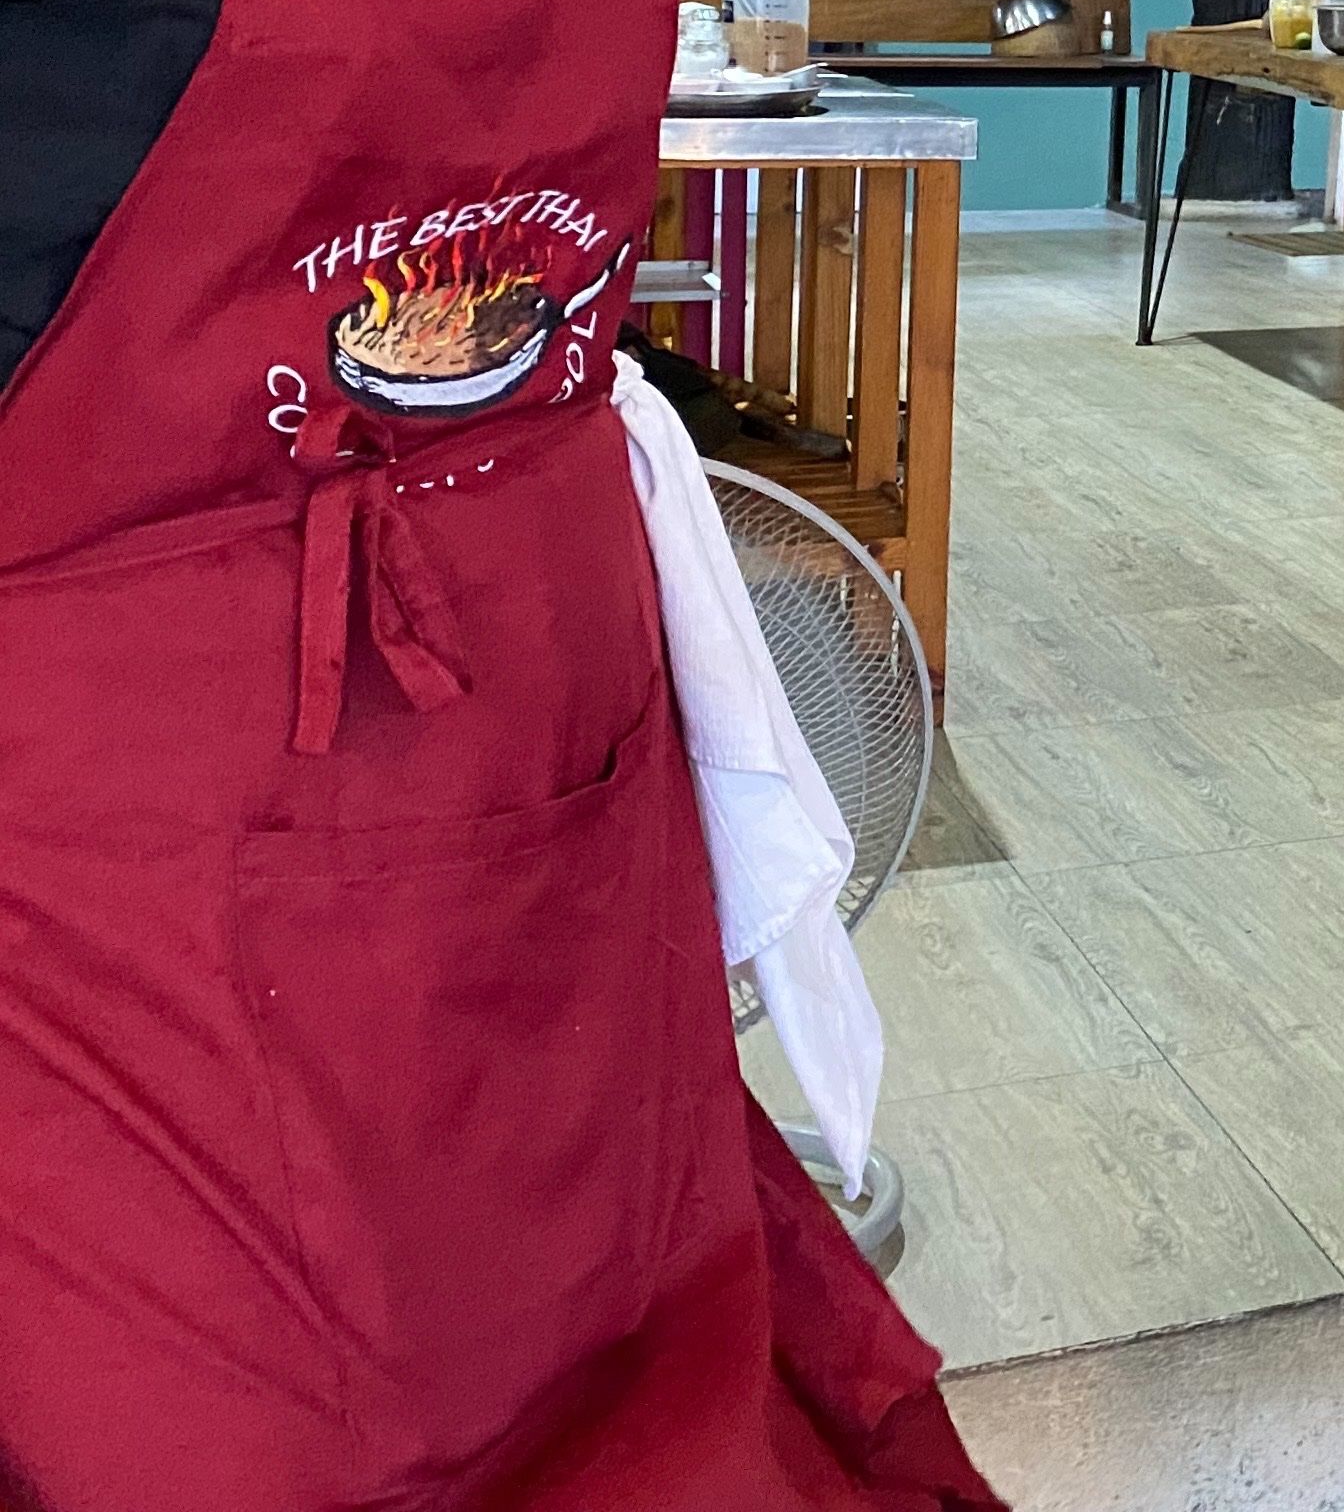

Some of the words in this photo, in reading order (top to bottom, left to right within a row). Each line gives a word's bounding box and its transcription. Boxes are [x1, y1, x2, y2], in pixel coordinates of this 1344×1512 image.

[293, 216, 408, 293] THE
[410, 191, 526, 248] BEST
[520, 189, 608, 252] THAI
